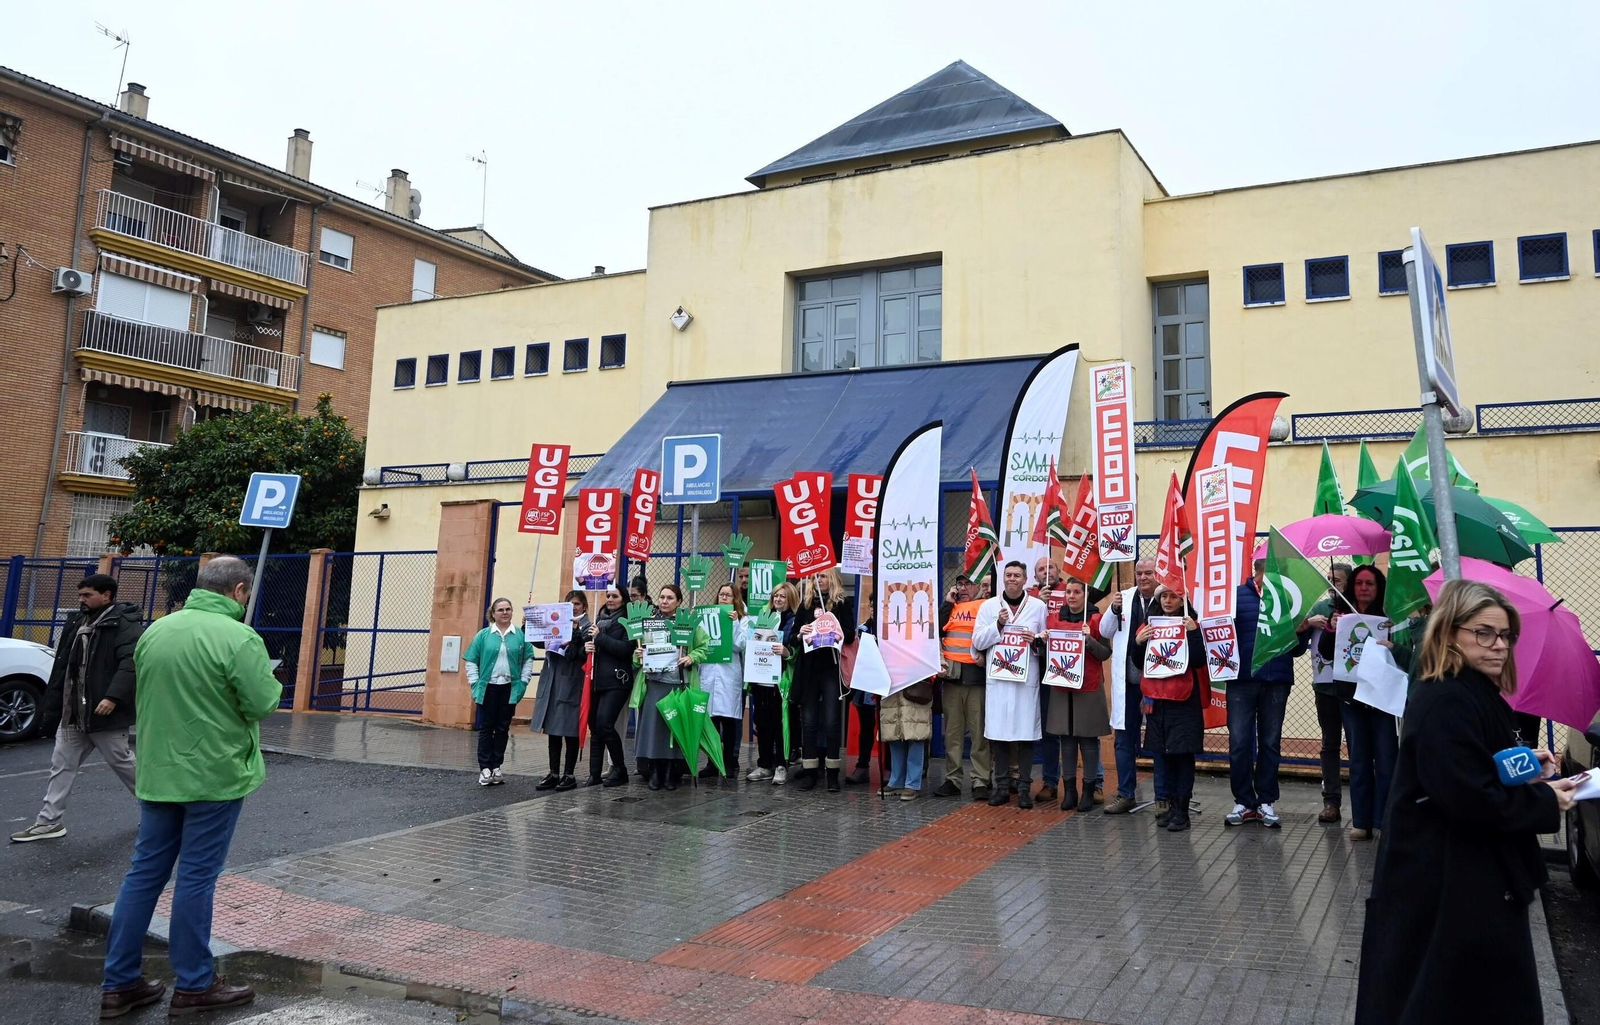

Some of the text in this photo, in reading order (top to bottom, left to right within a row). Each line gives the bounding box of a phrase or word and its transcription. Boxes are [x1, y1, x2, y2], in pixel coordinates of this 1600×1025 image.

[1102, 408, 1124, 498] CCOO
[674, 444, 707, 495] P
[1012, 472, 1048, 482] CÓRDOB
[533, 448, 562, 508] UGT
[251, 480, 286, 519] P
[634, 473, 656, 534] UGT
[782, 480, 820, 546] UGT
[854, 478, 882, 539] UGT
[586, 492, 612, 554] UGT
[1102, 512, 1130, 525] STOP
[1112, 527, 1128, 542] NO
[882, 537, 926, 560] SMA
[1076, 532, 1098, 570] Córdoba
[590, 562, 608, 570] STOP
[886, 560, 932, 570] CÓRDOBA
[1208, 514, 1226, 612] CCOO
[752, 569, 772, 594] NO
[817, 620, 834, 628] STOP
[1001, 634, 1024, 645] TOP
[1153, 627, 1181, 638] STOP
[1206, 628, 1230, 640] STOP
[1052, 641, 1080, 652] STOP
[1160, 642, 1178, 656] NO
[1218, 643, 1234, 657] NO
[1004, 648, 1020, 662] NO
[1060, 655, 1076, 669] NO
[1510, 752, 1535, 776] N
